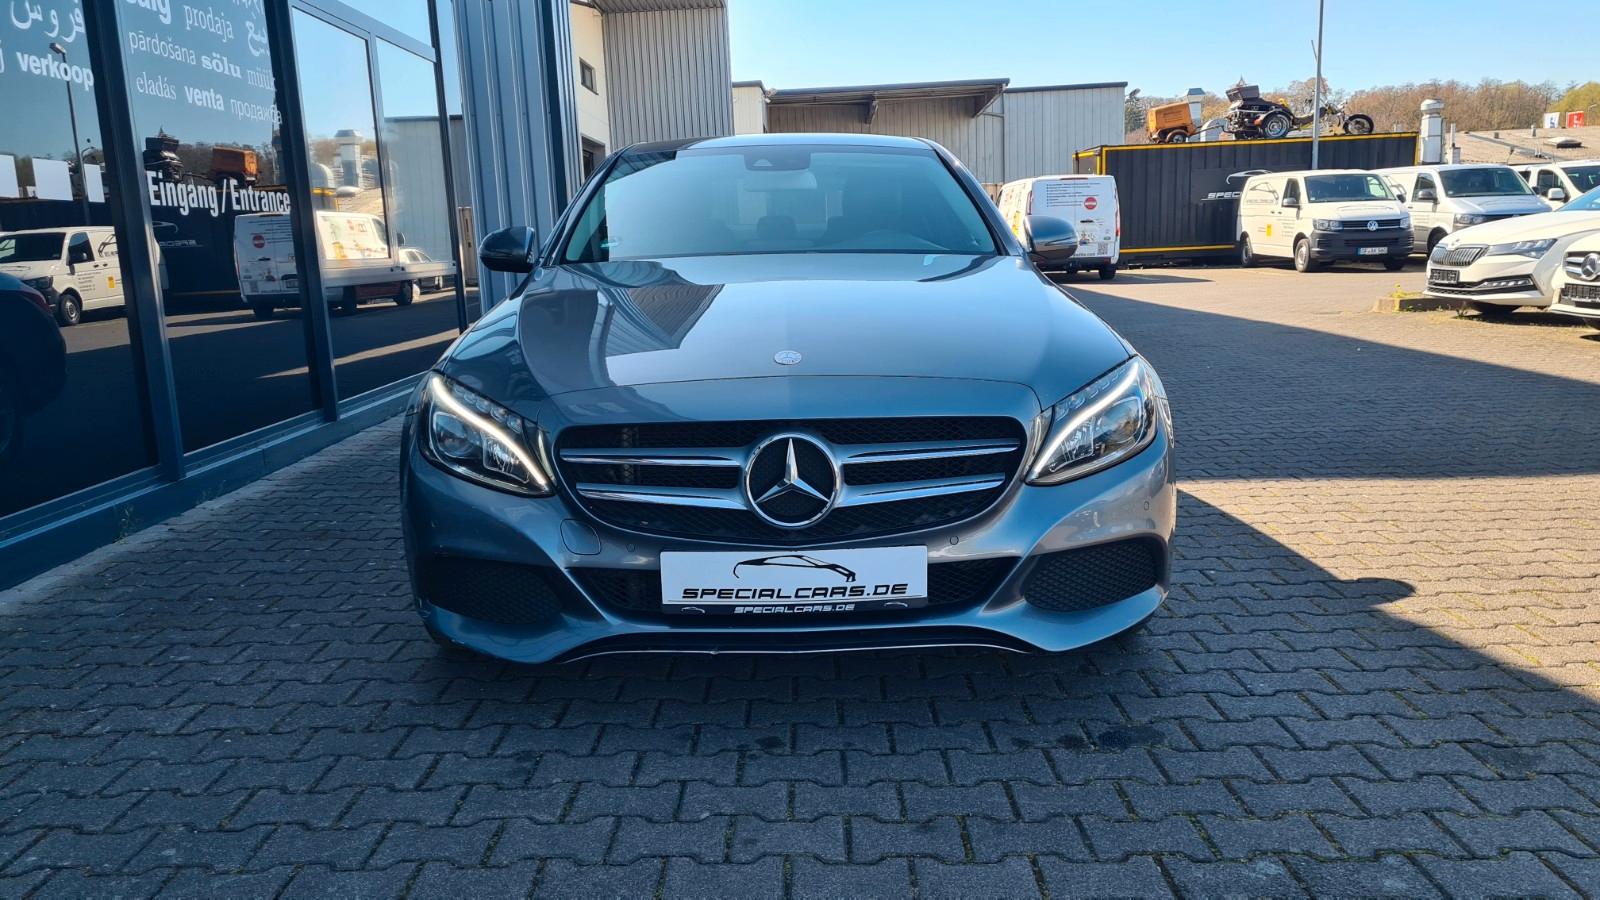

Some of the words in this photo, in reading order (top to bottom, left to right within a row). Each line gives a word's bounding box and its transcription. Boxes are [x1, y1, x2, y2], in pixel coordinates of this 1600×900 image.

[183, 5, 234, 43] prodaja
[16, 51, 94, 91] verkoop
[128, 30, 197, 65] pārdošana
[201, 52, 242, 79] sölu
[136, 71, 177, 100] eladás
[184, 85, 225, 111] venta
[682, 583, 908, 599] SPECIALCARS.DE
[734, 603, 856, 614] SPECIALCARS.DE
